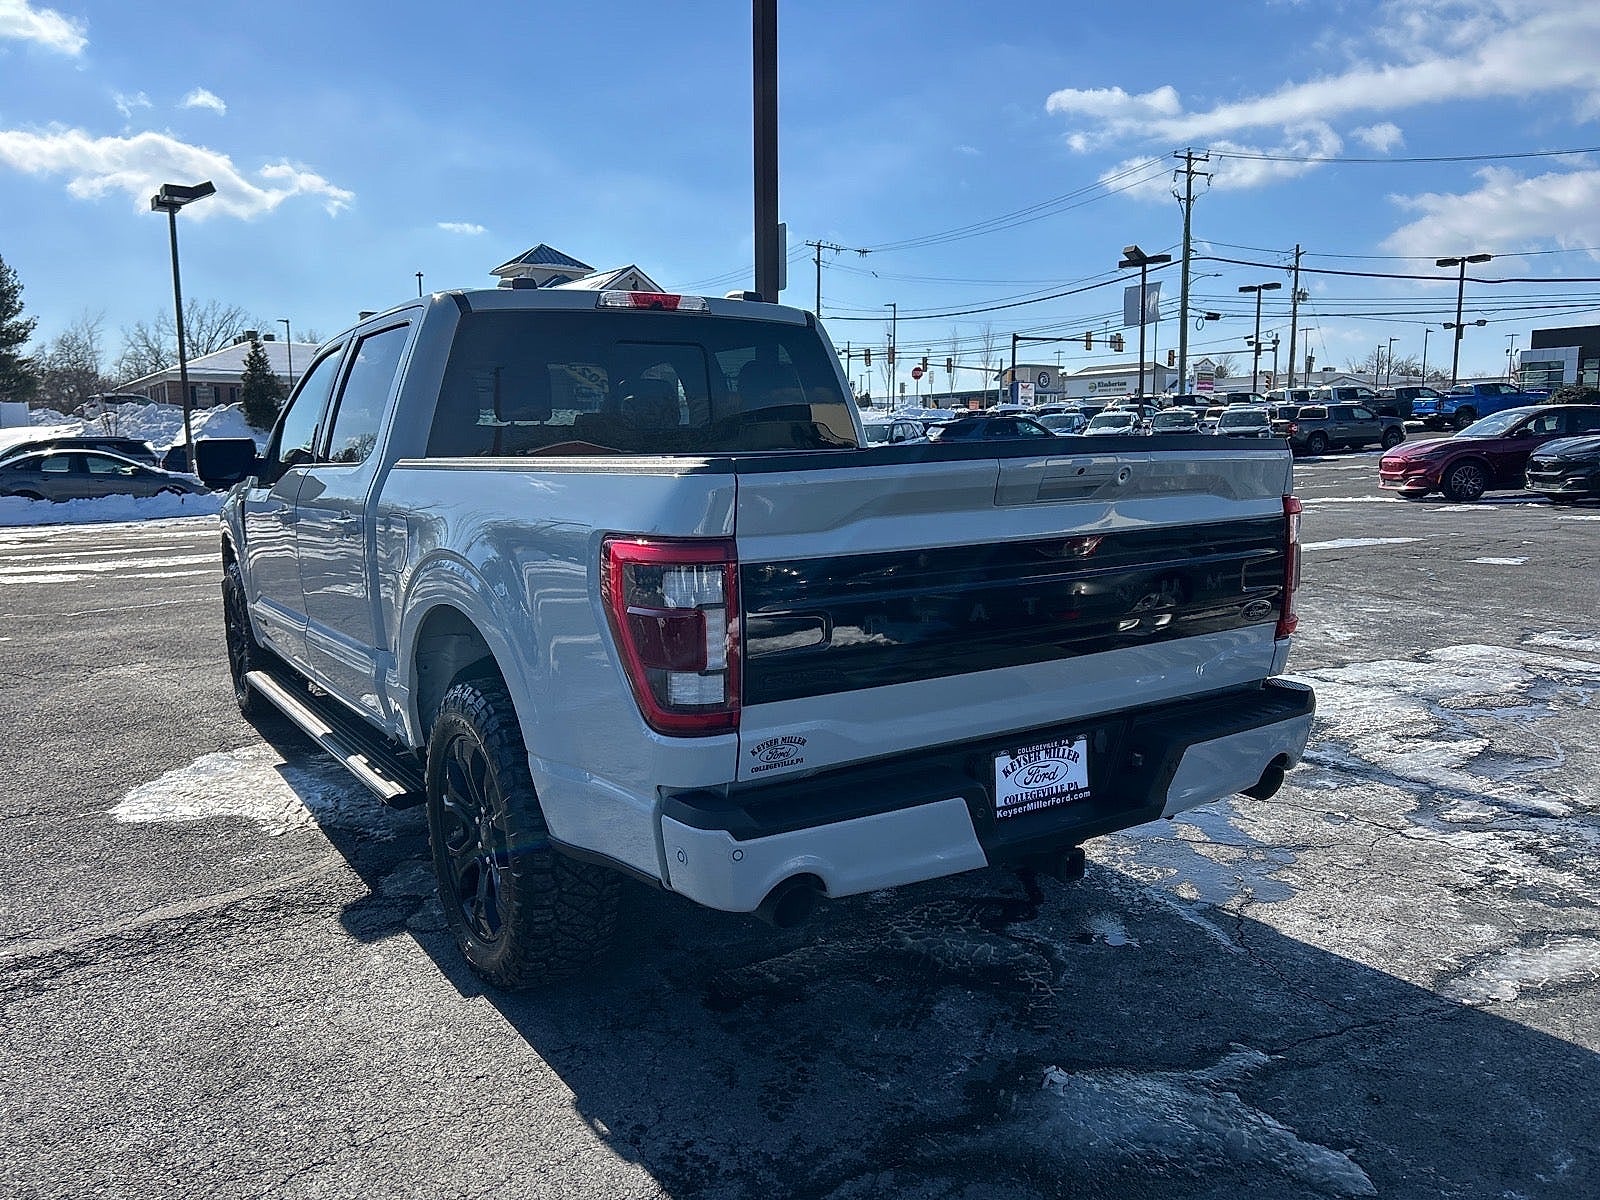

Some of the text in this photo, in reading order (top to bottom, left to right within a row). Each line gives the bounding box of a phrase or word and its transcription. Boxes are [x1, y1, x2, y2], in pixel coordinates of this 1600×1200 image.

[750, 735, 807, 756] KEYSER MILLER
[766, 746, 792, 761] Ford
[1001, 746, 1080, 779] KEYSER MILLER
[1023, 763, 1060, 786] Ford
[996, 790, 1091, 818] KeyserMillerFord.com
